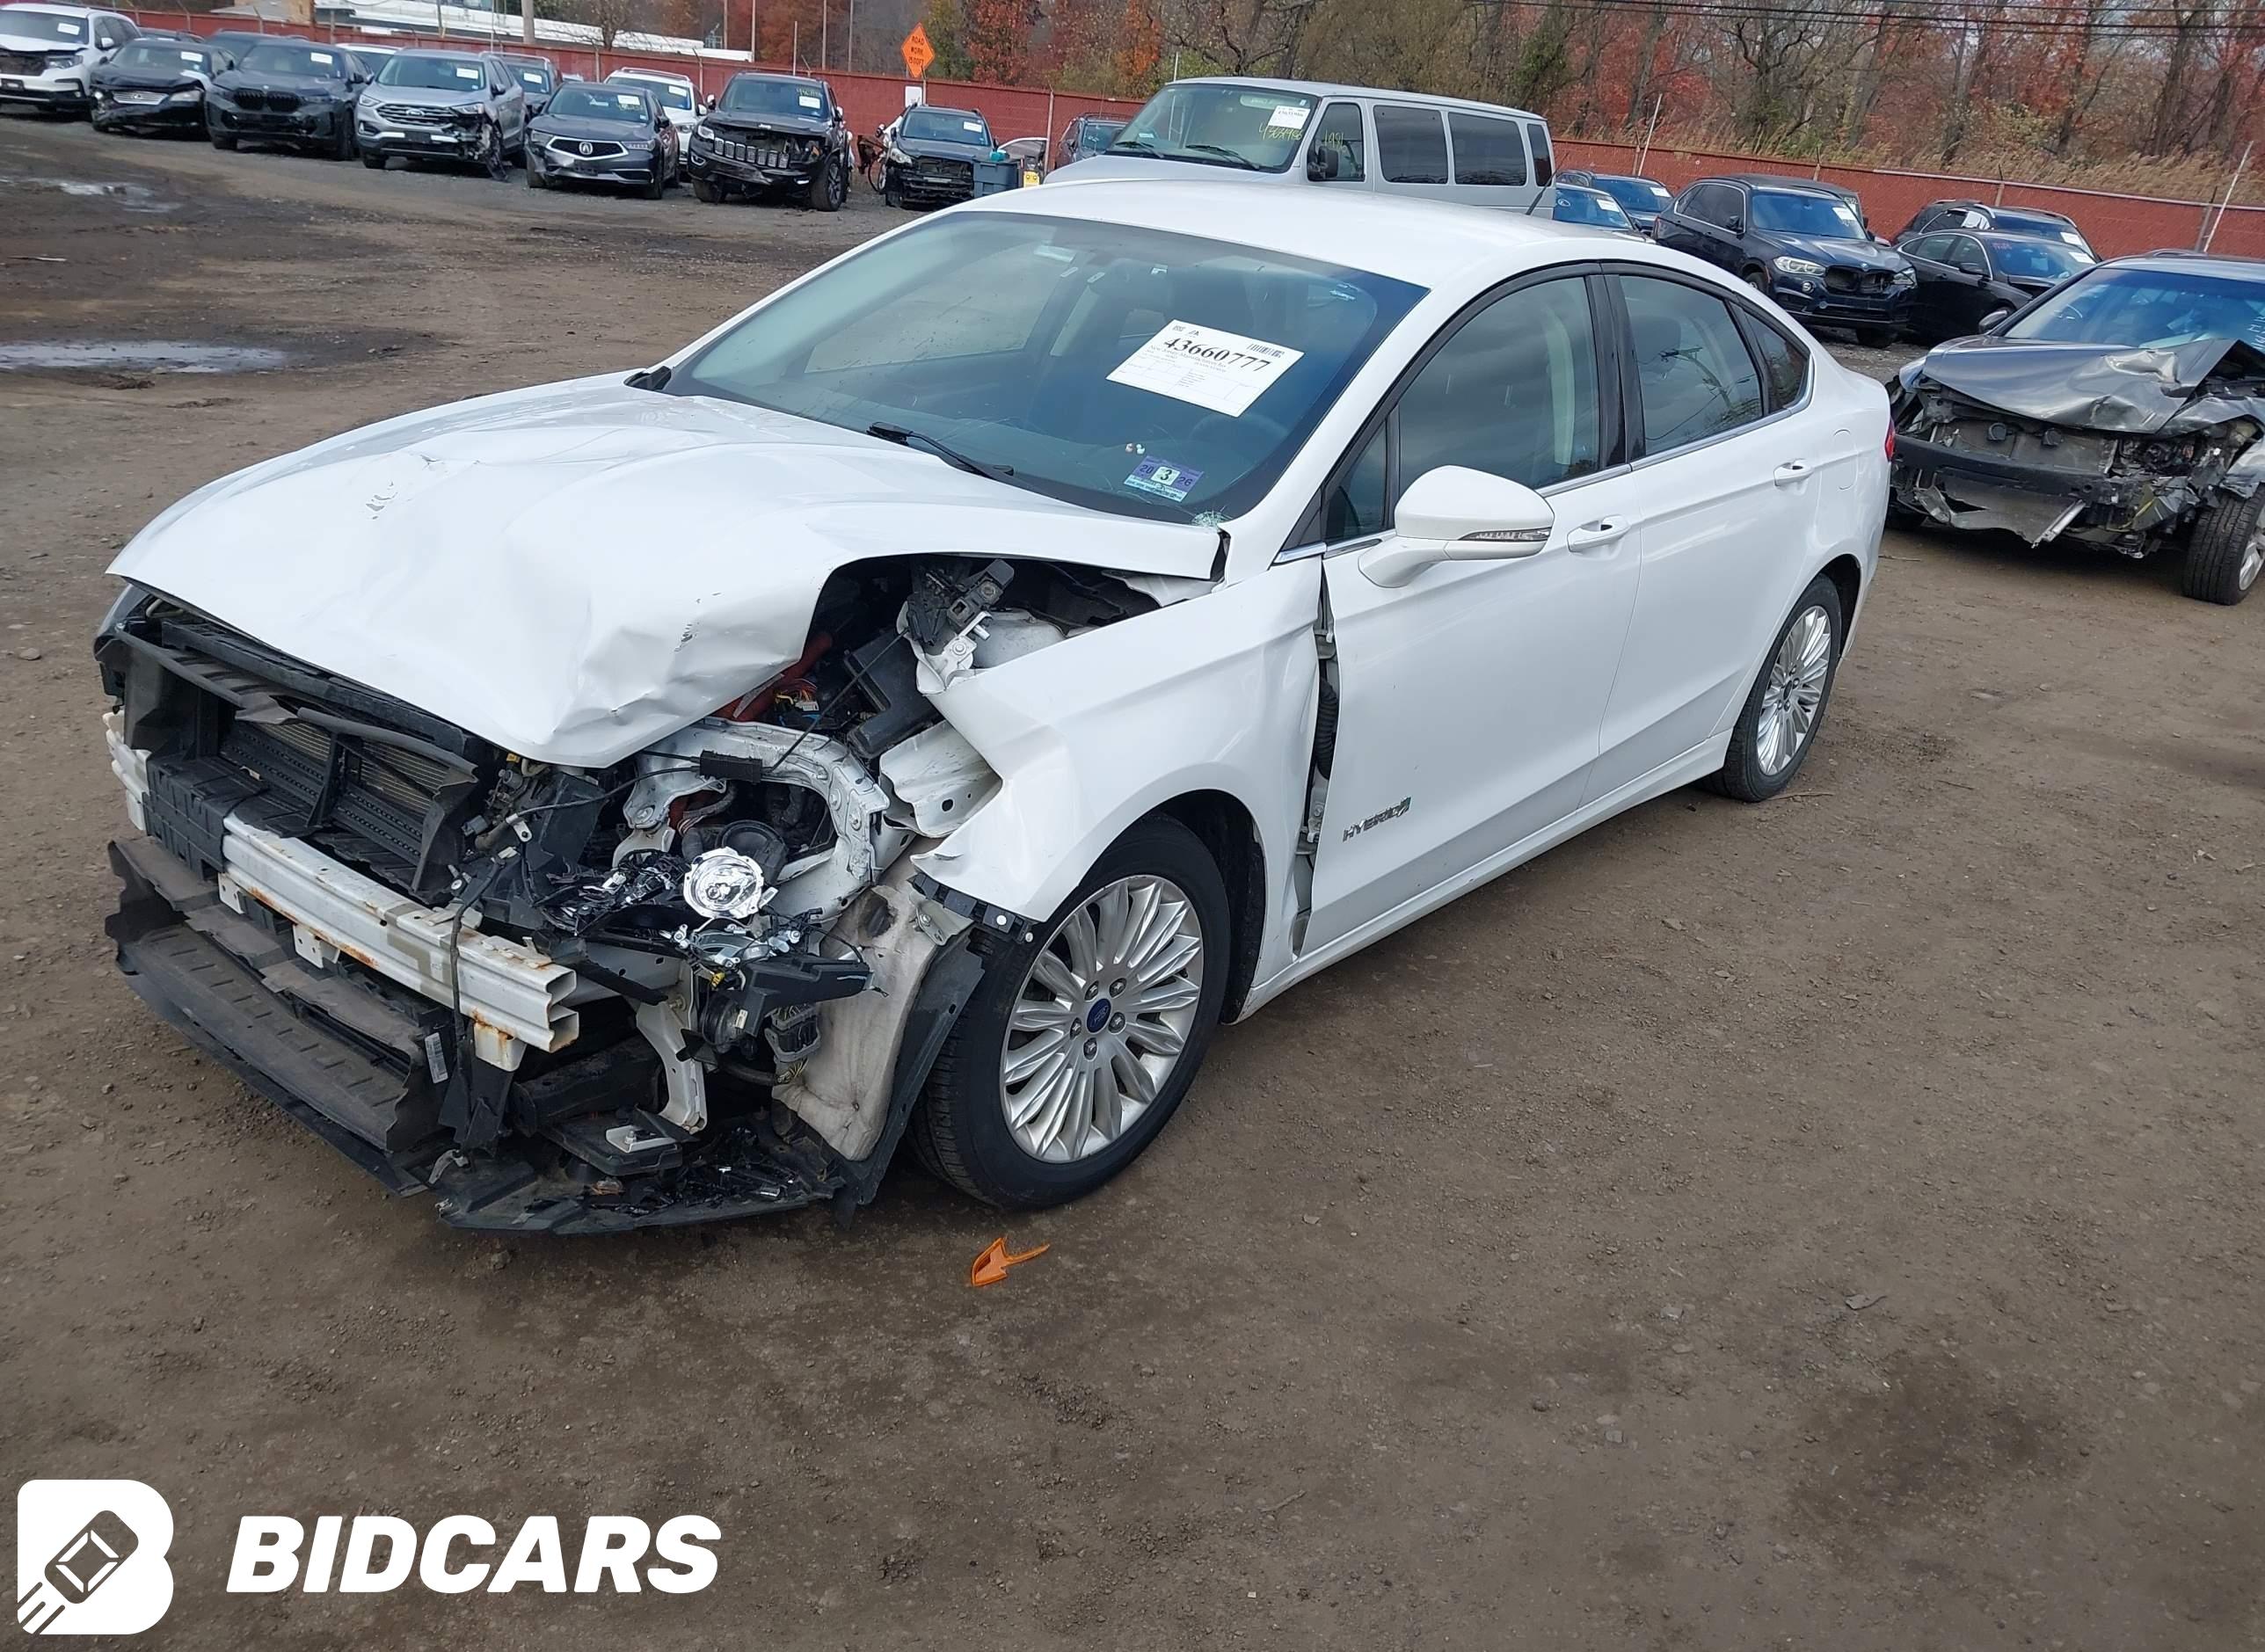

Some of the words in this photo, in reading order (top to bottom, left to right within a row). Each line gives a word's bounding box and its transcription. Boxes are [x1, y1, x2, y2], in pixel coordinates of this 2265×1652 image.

[912, 36, 924, 45] ROAD
[1164, 338, 1271, 372] 43660777
[1140, 464, 1154, 474] 20
[1160, 469, 1172, 481] 3
[1179, 477, 1192, 486] 26
